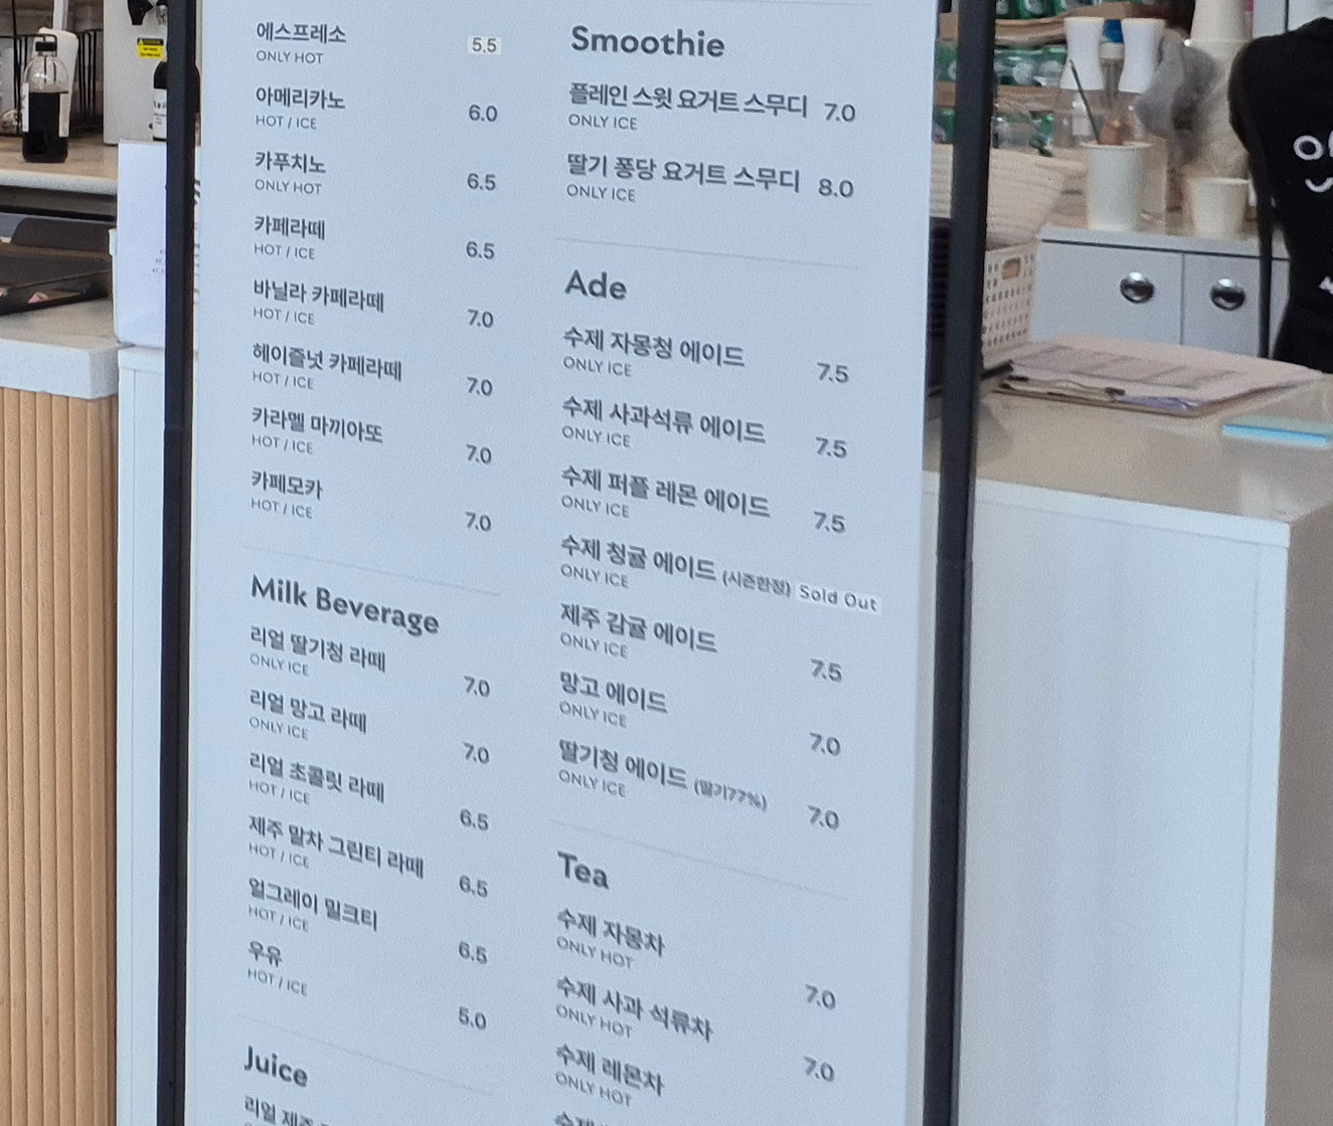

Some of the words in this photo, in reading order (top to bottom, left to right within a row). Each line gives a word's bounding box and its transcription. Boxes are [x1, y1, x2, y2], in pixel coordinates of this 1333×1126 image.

[256, 50, 291, 63] ONLY
[295, 52, 323, 64] HOT
[257, 22, 346, 44] 에스프레소
[473, 37, 496, 53] 5.5
[572, 26, 724, 57] Smoothie
[256, 87, 345, 109] 아메리카노
[469, 105, 497, 122] 6.0
[570, 83, 627, 107] 플레인
[633, 87, 672, 109] 스윗
[677, 90, 739, 112] 요거트
[744, 94, 807, 118] 스무디
[825, 103, 855, 122] 7.0
[256, 151, 326, 173] 카푸치노
[467, 173, 496, 191] 6.5
[568, 154, 607, 177] 딸기
[615, 157, 656, 180] 퐁당
[663, 162, 726, 185] 요거트
[734, 167, 799, 193] 스무디
[819, 179, 853, 198] 8.0
[255, 216, 325, 240] 카페라떼
[466, 241, 494, 259] 6.5
[254, 280, 306, 303] 바닐라
[313, 286, 384, 313] 카페라떼
[468, 309, 494, 328] 7.0
[565, 270, 626, 300] Ade
[253, 343, 323, 370] 헤이즐넛
[330, 354, 401, 381] 카페라떼
[468, 377, 493, 396] 7.0
[564, 327, 604, 351] 수제
[611, 333, 672, 359] 자몽청
[680, 341, 744, 367] 에이드
[817, 363, 849, 383] 7.5
[253, 408, 304, 432] 카라멜
[311, 416, 382, 443] 마끼아또
[467, 444, 492, 464] 7.0
[563, 396, 602, 421] 수제
[609, 403, 693, 434] 사과석류
[700, 416, 765, 443] 에이드
[816, 437, 847, 458] 7.5
[252, 471, 322, 500] 카페모카
[466, 512, 491, 531] 7.0
[562, 466, 601, 491] 수제
[608, 473, 649, 499] 퍼플
[656, 481, 697, 507] 레몬
[704, 489, 770, 517] 에이드
[814, 511, 845, 533] 7.5
[562, 535, 600, 561] 수제
[653, 552, 716, 580] 에이드
[799, 585, 837, 604] Sold
[845, 593, 876, 611] Out
[252, 575, 307, 607] Milk
[317, 587, 439, 637] Beverage
[251, 627, 284, 650] 리얼
[291, 634, 343, 663] 딸기청
[350, 647, 385, 673] 라떼
[465, 676, 490, 697] 7.0
[561, 604, 600, 629] 제주
[607, 612, 647, 640] 감귤
[654, 623, 717, 652] 에이드
[811, 659, 842, 682] 7.5
[560, 672, 600, 697] 망고
[606, 683, 667, 713] 에이드
[810, 733, 840, 756] 7.0
[558, 851, 609, 889] Tea
[244, 1046, 307, 1087] Juice
